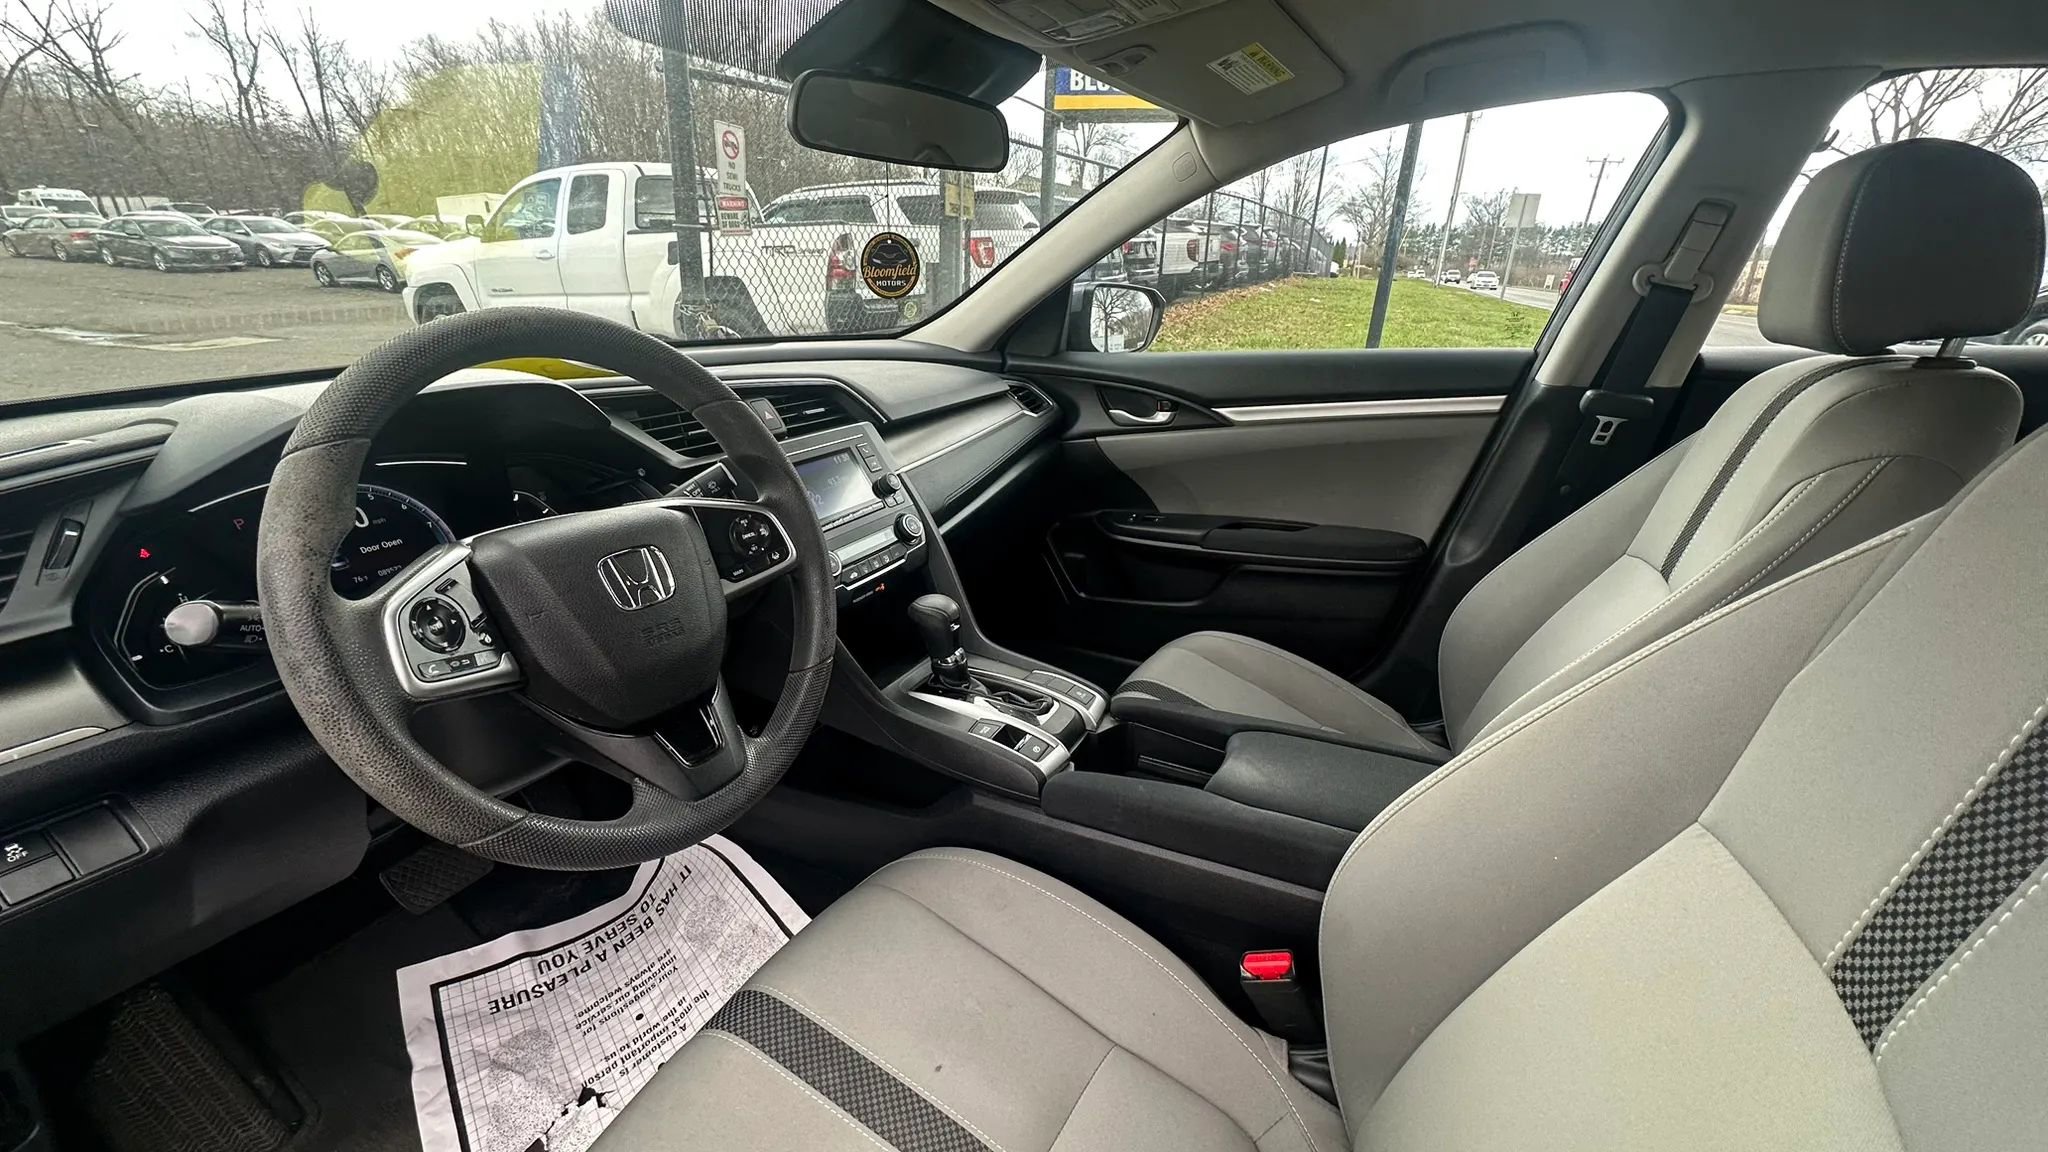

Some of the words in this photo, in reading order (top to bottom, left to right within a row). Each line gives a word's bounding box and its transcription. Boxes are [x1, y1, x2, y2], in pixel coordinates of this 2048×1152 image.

[862, 264, 918, 281] Bloomfield
[360, 544, 380, 554] Door
[381, 538, 403, 549] Open
[240, 624, 261, 632] AUTO
[680, 865, 692, 884] IT
[640, 893, 657, 913] TO
[655, 882, 679, 917] HAS
[582, 914, 638, 955] SERVE
[613, 916, 655, 954] BEEN
[537, 950, 579, 975] YOU
[596, 949, 608, 963] A
[657, 948, 672, 961] are
[624, 961, 656, 988] always
[632, 955, 677, 993] improving
[658, 966, 678, 984] Your
[488, 959, 592, 1015] PLEASURE
[693, 990, 710, 1003] the
[599, 982, 656, 1025] suggestions
[615, 992, 630, 1005] our
[575, 1004, 613, 1030] service
[662, 1007, 677, 1021] the
[671, 1004, 693, 1026] most
[582, 1024, 597, 1037] for
[632, 1022, 661, 1046] world
[619, 1041, 631, 1052] to
[620, 1026, 669, 1064] important
[632, 1030, 678, 1070] customer
[581, 1062, 618, 1089] person
[619, 1068, 629, 1077] is
